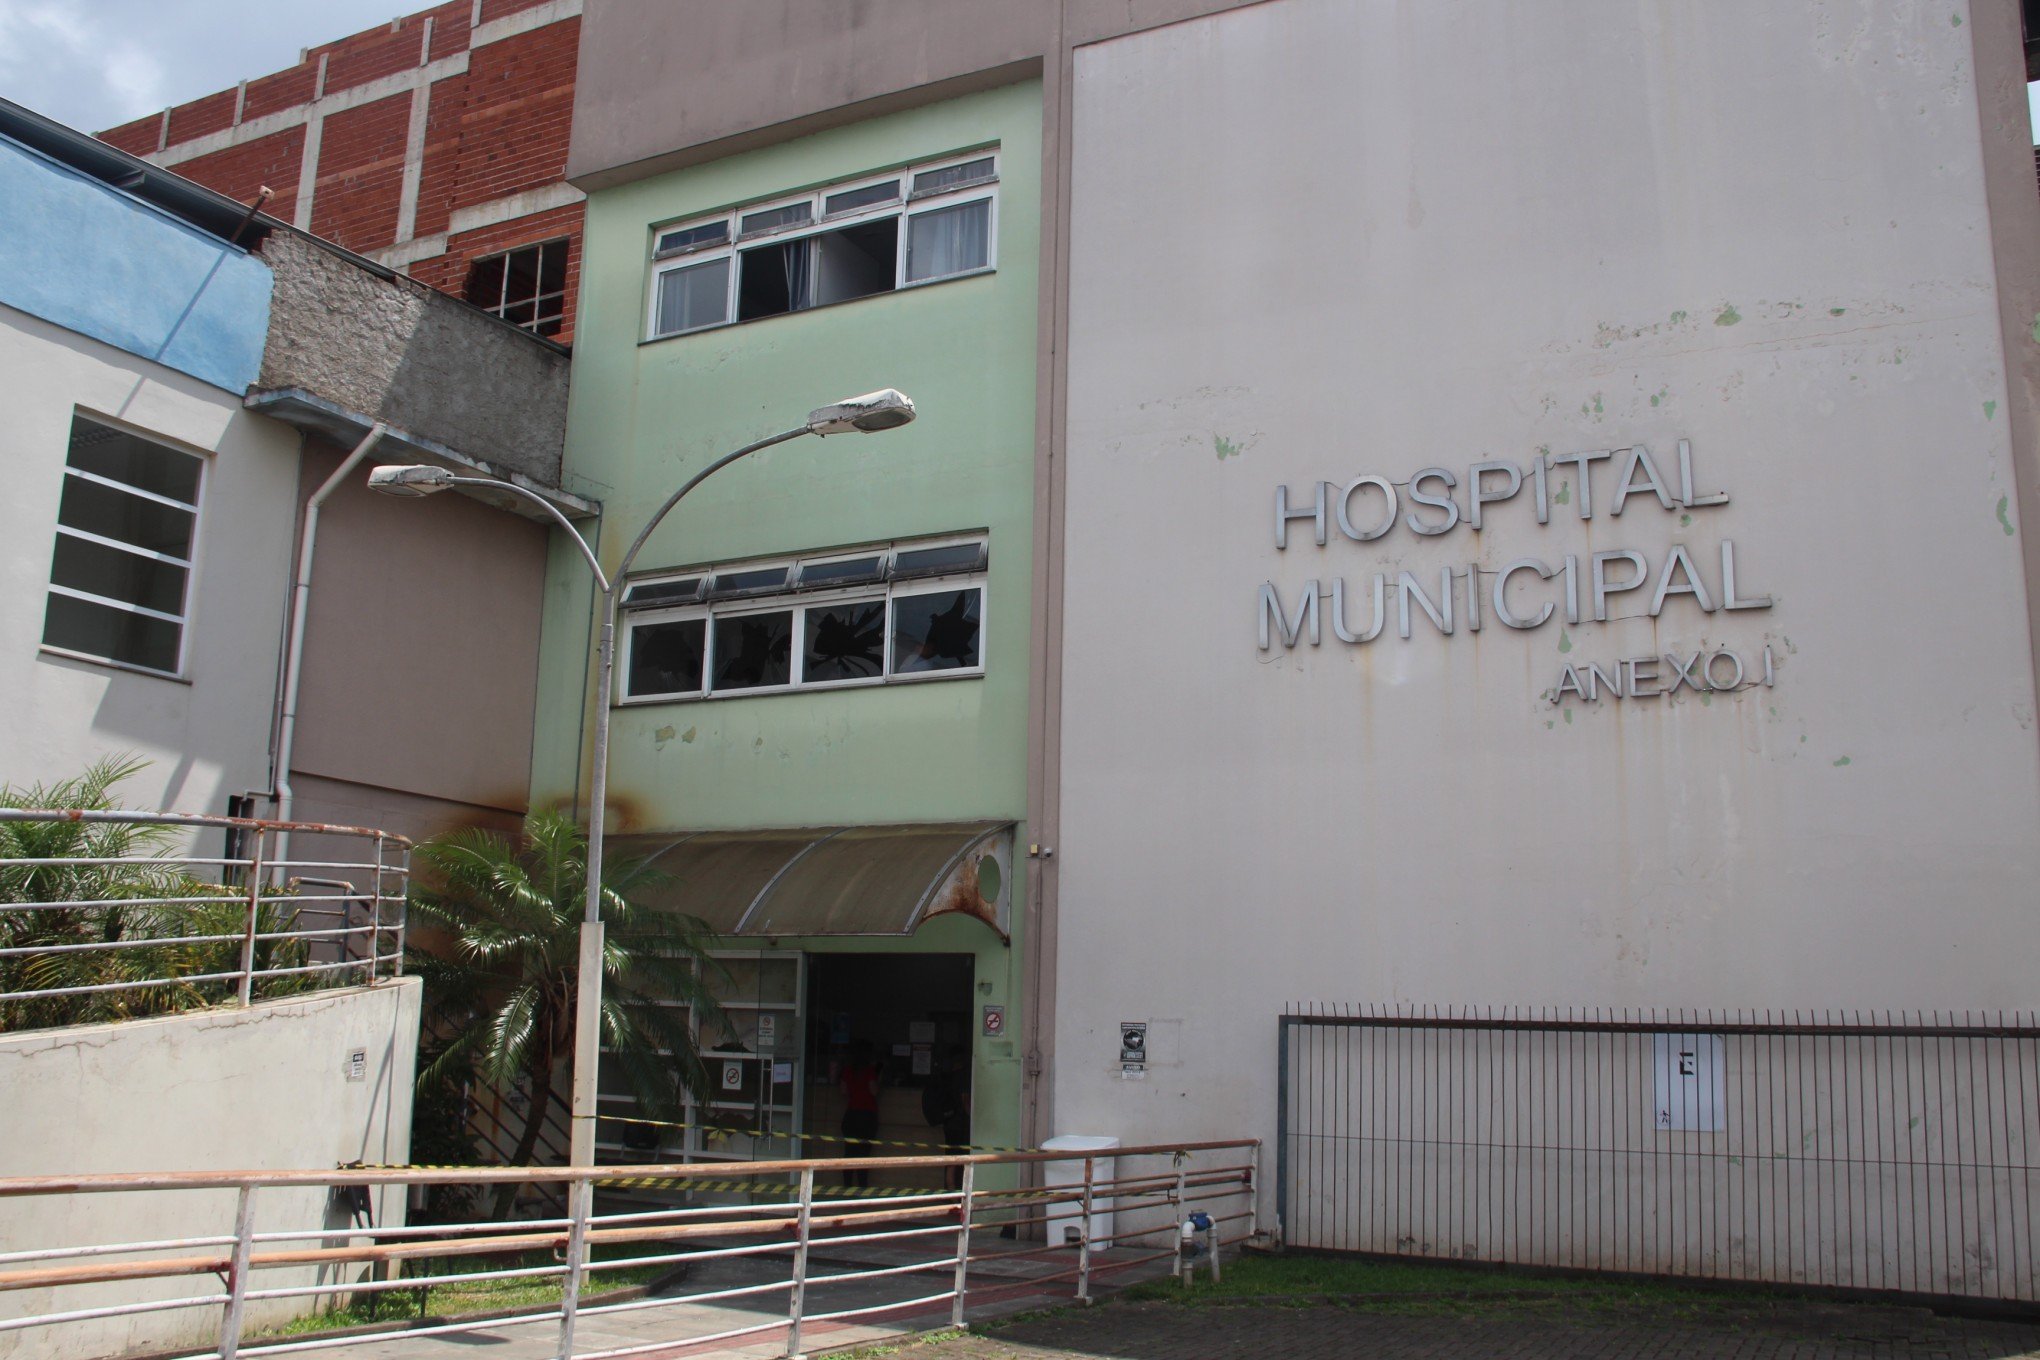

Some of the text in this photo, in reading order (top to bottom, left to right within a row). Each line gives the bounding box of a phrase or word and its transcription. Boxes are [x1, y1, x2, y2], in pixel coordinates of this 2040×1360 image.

[1275, 439, 1728, 549] HOSPITAL
[1258, 540, 1772, 650] MUNICIPAL
[1553, 645, 1774, 703] ANEXO I
